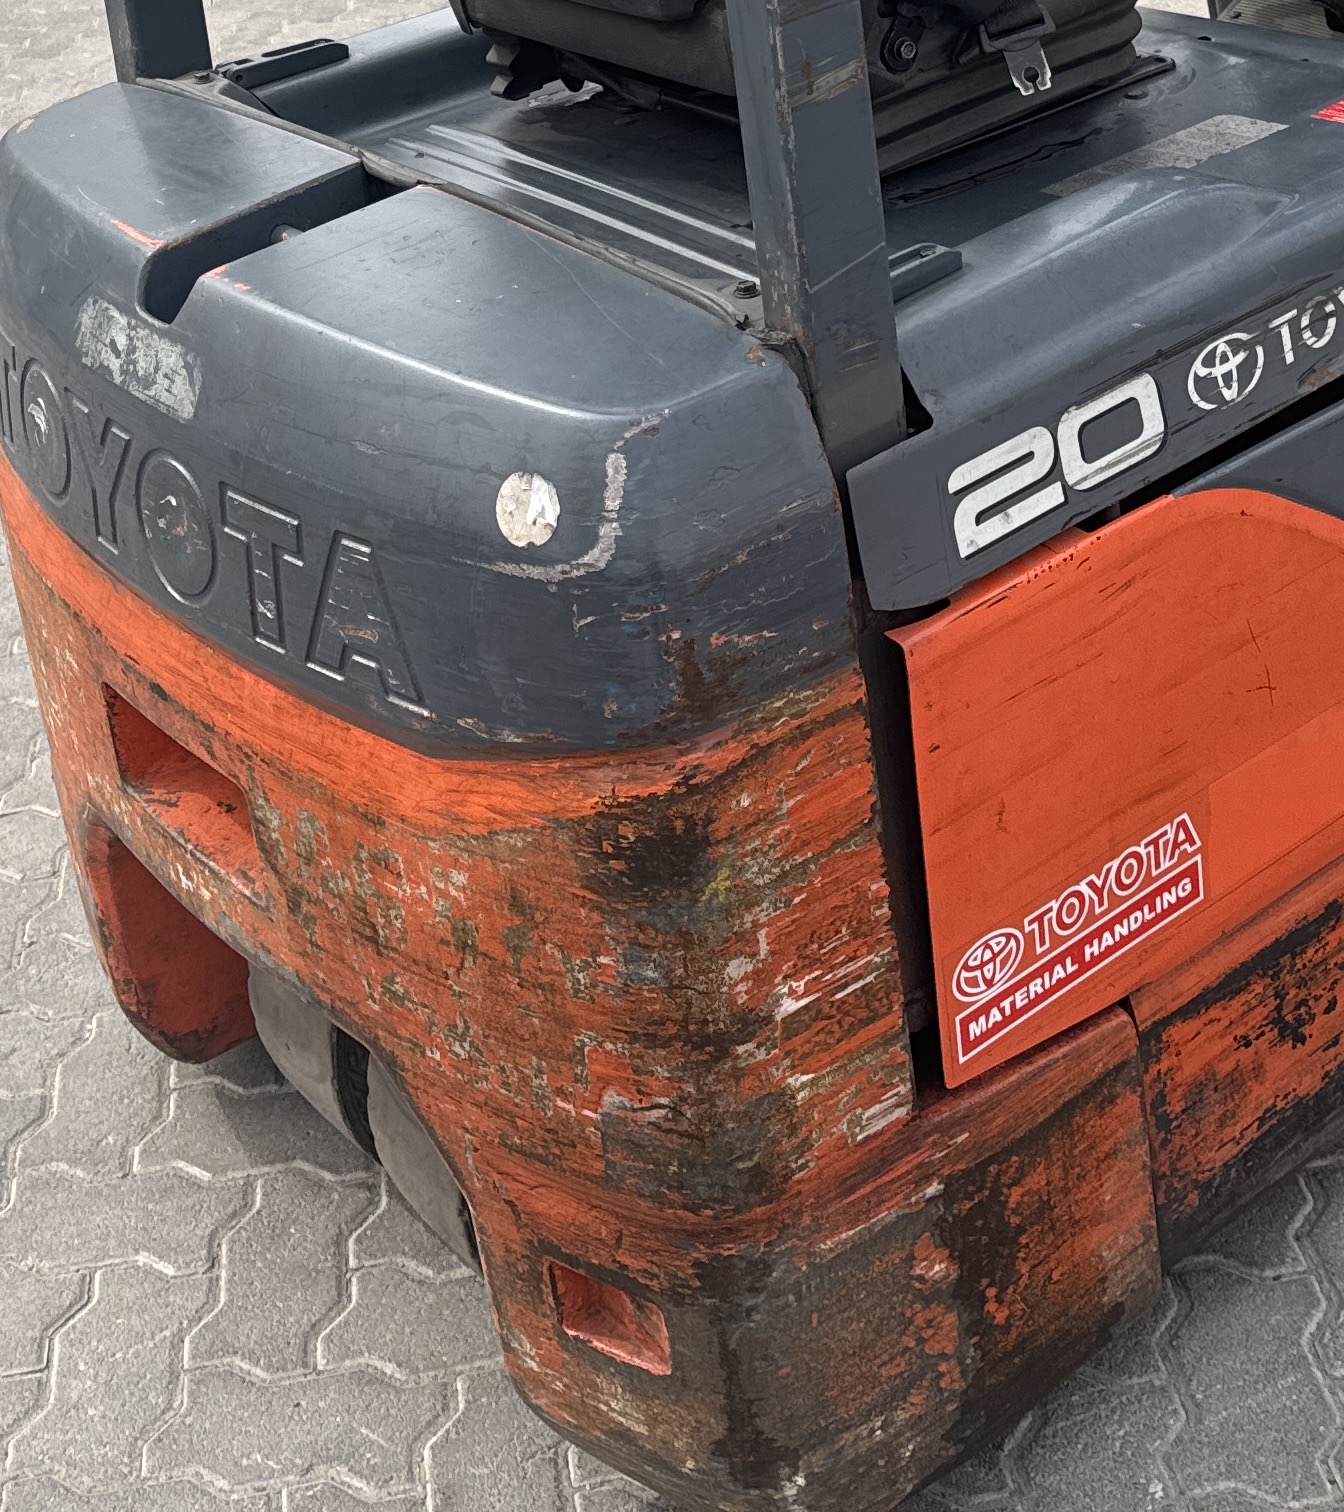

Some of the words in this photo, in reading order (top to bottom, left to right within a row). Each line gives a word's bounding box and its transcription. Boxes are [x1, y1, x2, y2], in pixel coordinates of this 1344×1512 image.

[947, 371, 1168, 561] 20
[967, 956, 1080, 1043] MATERIAL
[1084, 876, 1193, 963] HANDLING
[1023, 812, 1202, 955] TOYOTA
